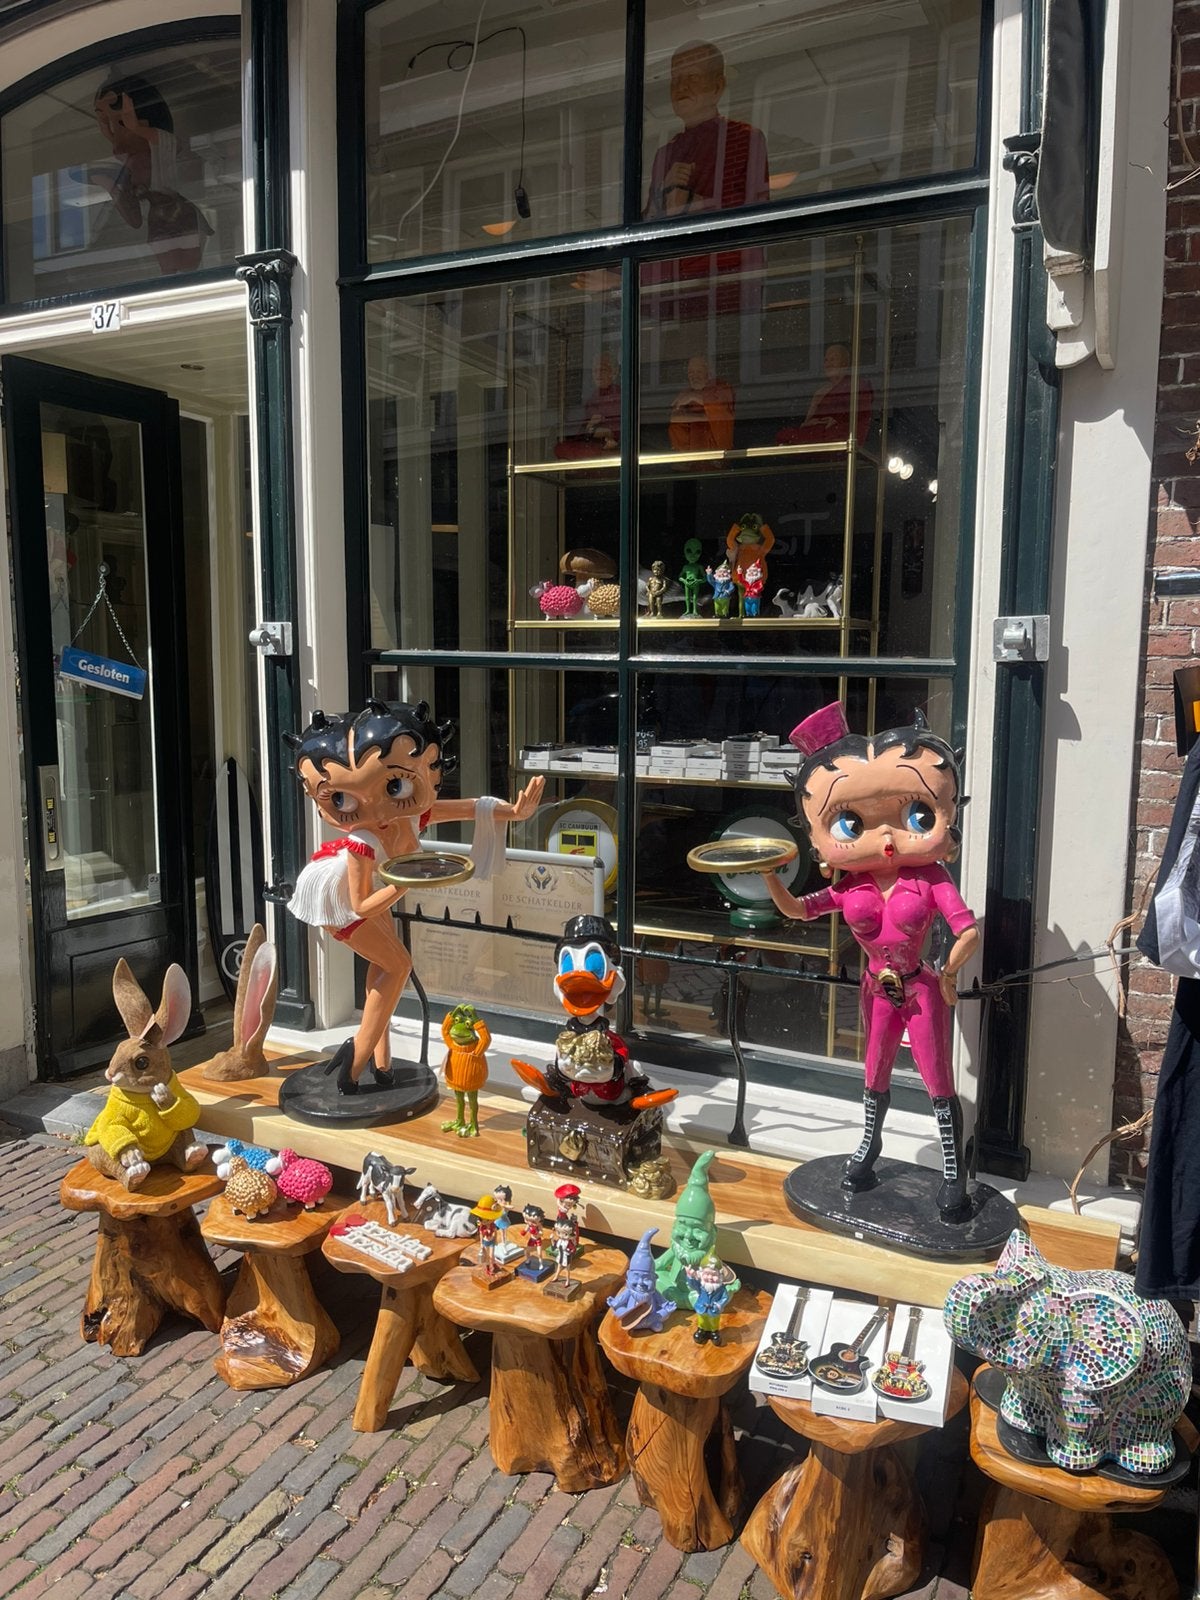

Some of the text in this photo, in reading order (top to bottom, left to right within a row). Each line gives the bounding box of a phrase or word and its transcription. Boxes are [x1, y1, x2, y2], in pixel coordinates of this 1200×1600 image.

[95, 303, 116, 329] 37
[78, 659, 130, 684] Gesloten
[516, 895, 583, 911] SCHATKELDER
